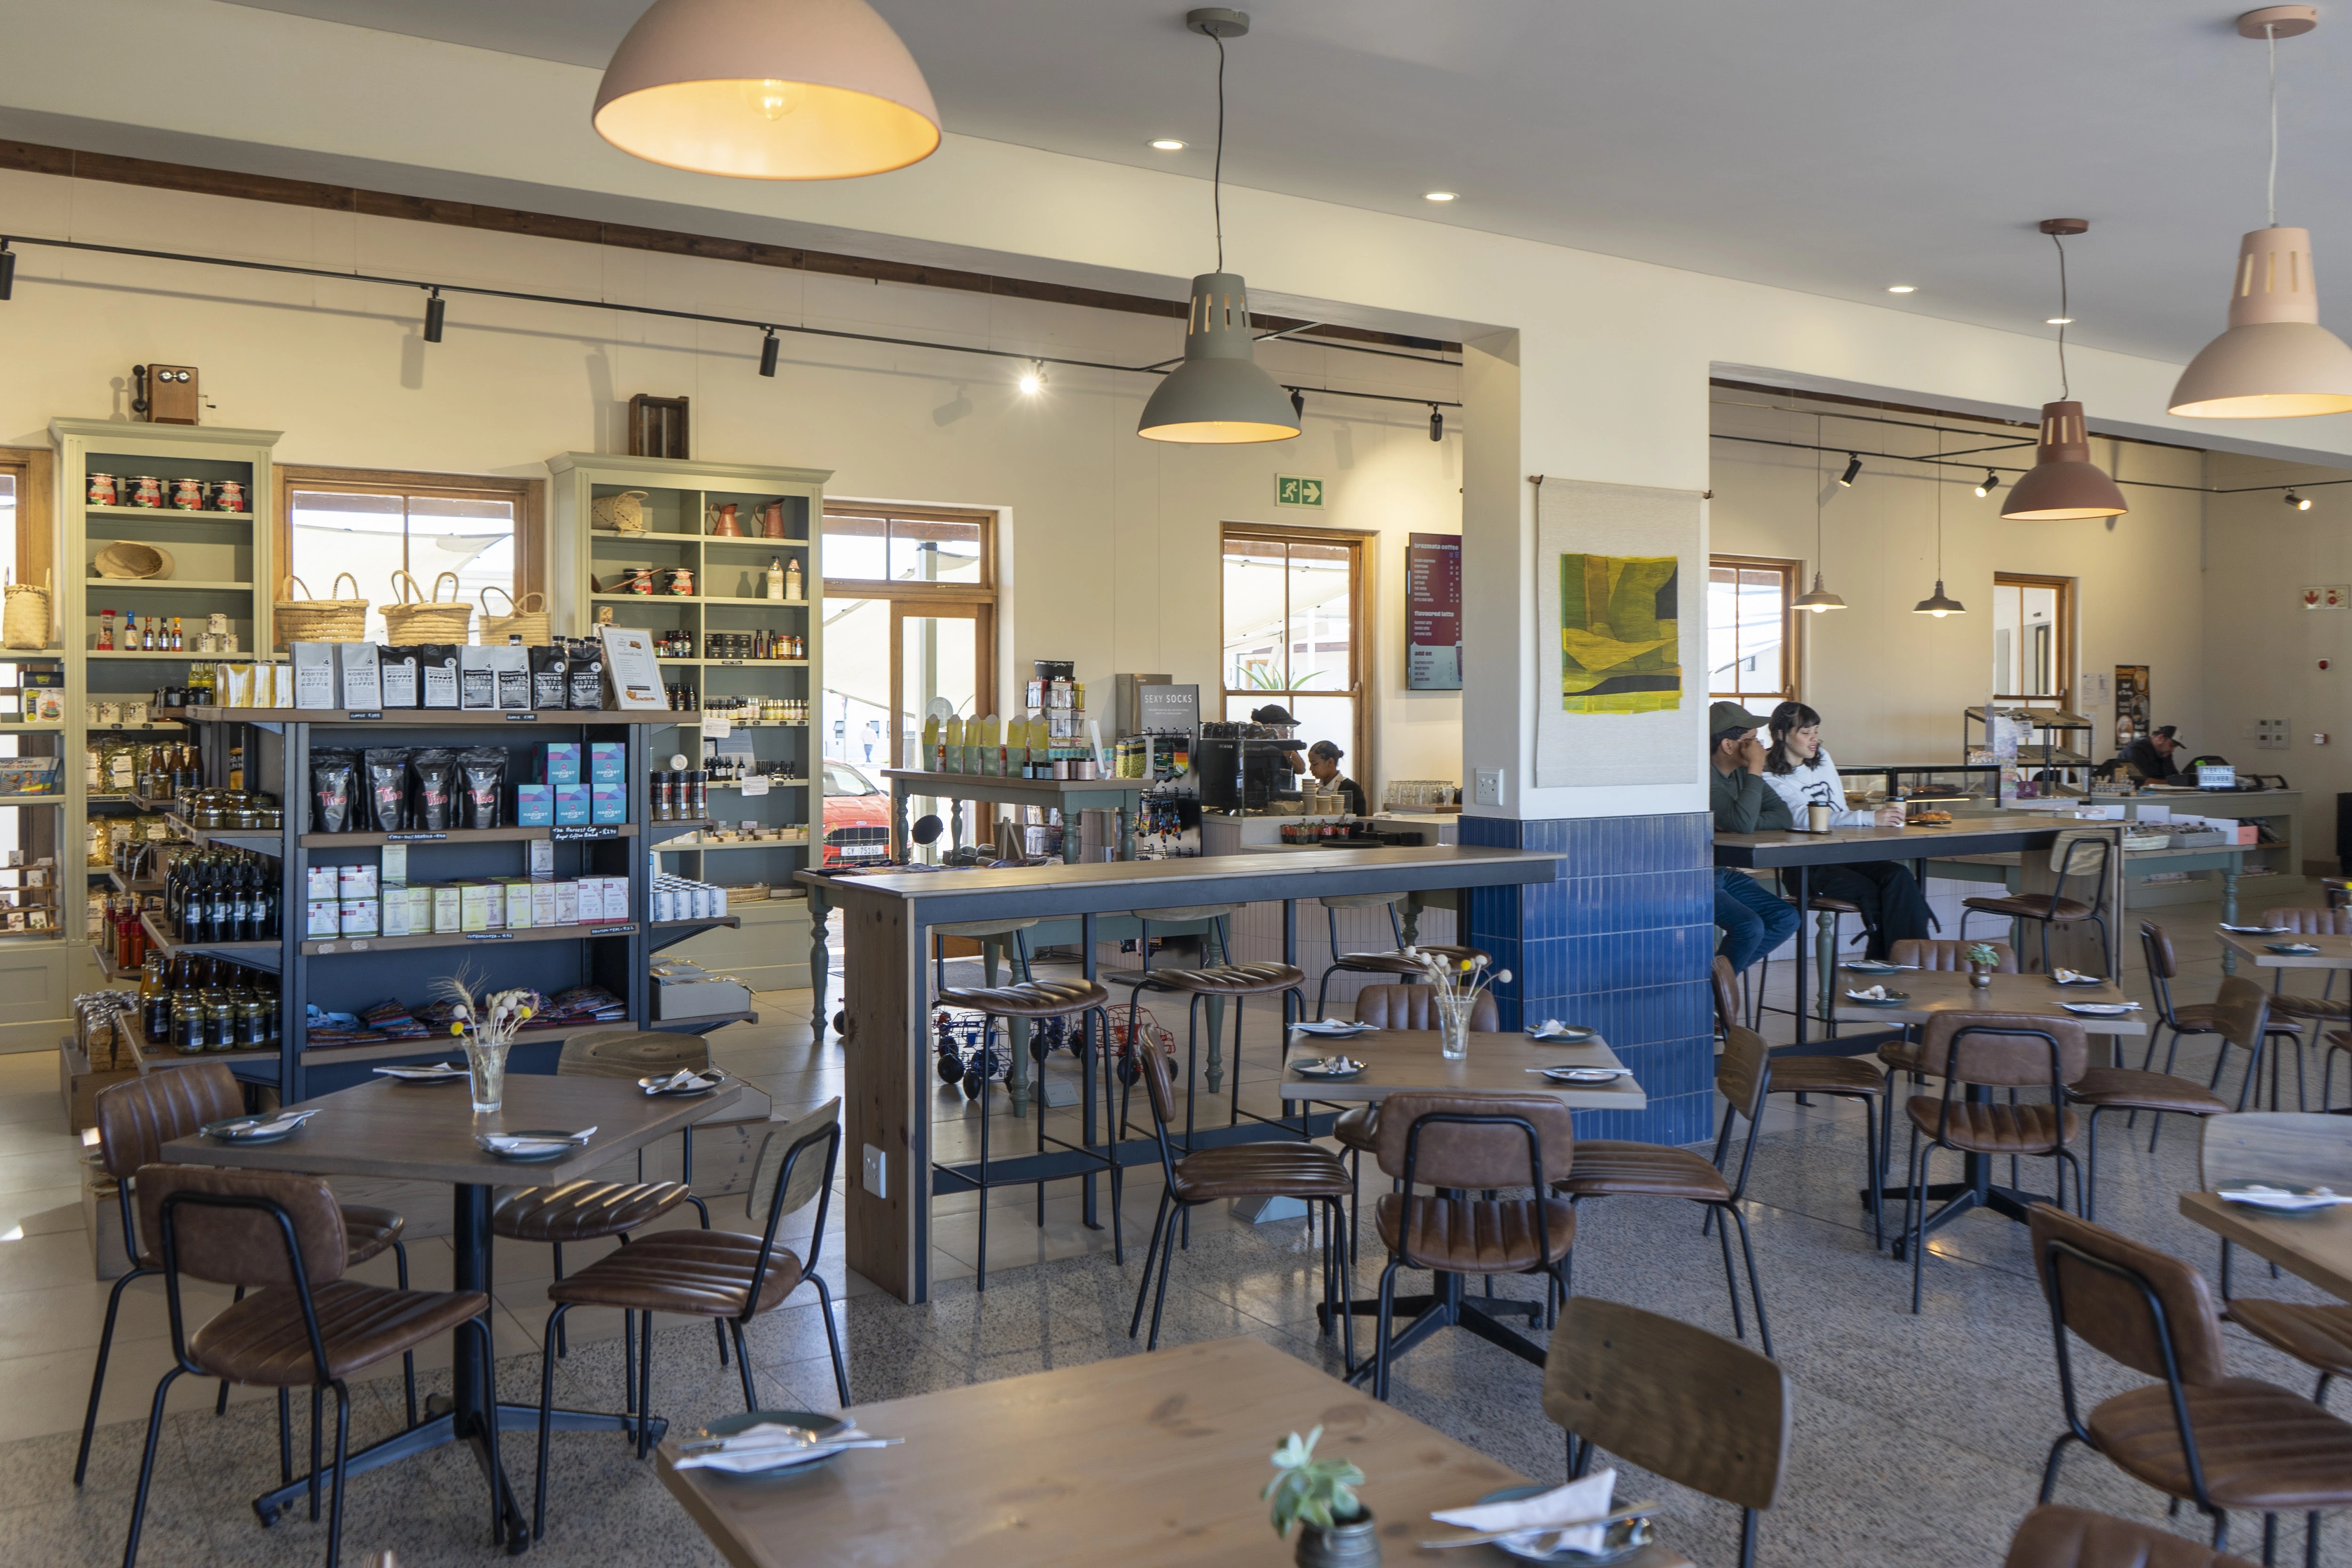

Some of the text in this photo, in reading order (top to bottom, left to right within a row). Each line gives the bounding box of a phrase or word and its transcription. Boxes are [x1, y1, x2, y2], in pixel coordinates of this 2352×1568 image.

[1166, 694, 1192, 703] SOCKS
[317, 791, 346, 806] Tino
[376, 787, 403, 802] Tino
[422, 790, 448, 806] Tino
[467, 789, 494, 804] Tino
